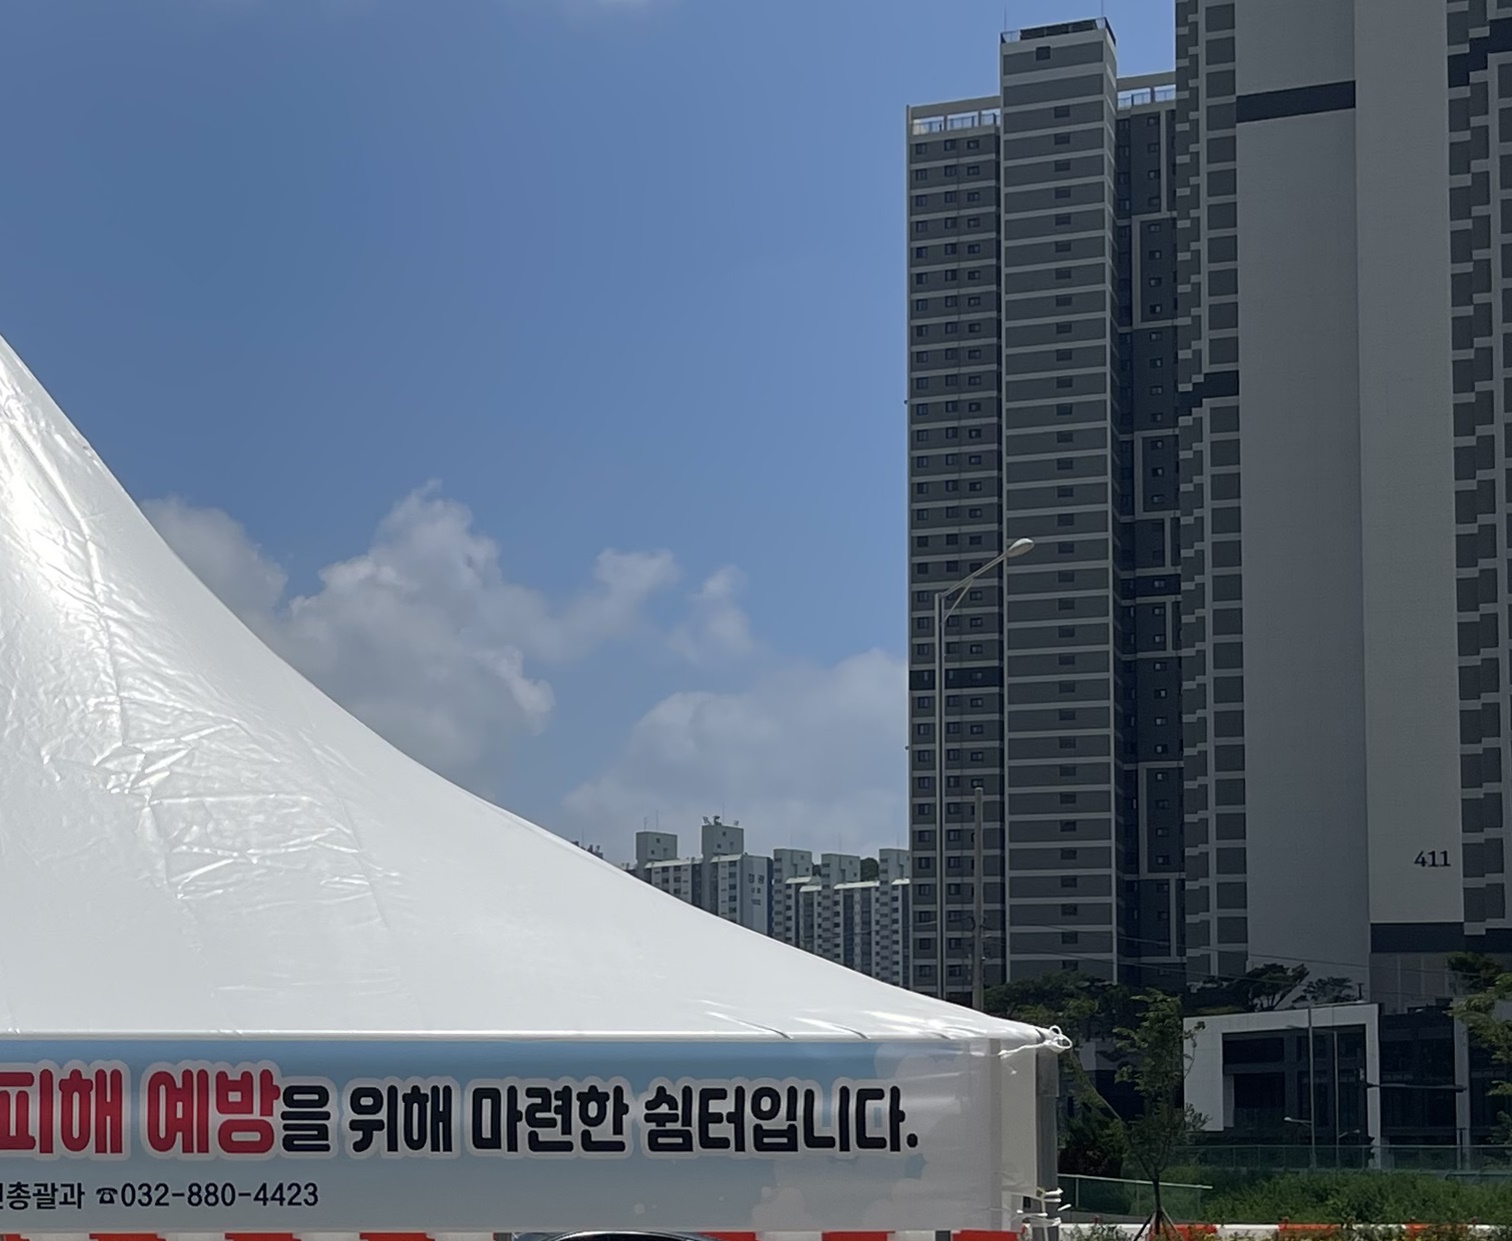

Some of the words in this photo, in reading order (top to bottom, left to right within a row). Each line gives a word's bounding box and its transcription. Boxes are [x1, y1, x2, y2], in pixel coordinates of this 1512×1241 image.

[1414, 850, 1451, 868] 411
[147, 1068, 332, 1154] 예방을
[349, 1085, 453, 1153] 위해
[471, 1085, 629, 1153] 마련한
[643, 1085, 919, 1152] 쉼터입니다.
[121, 1181, 319, 1208] 032-880-4423
